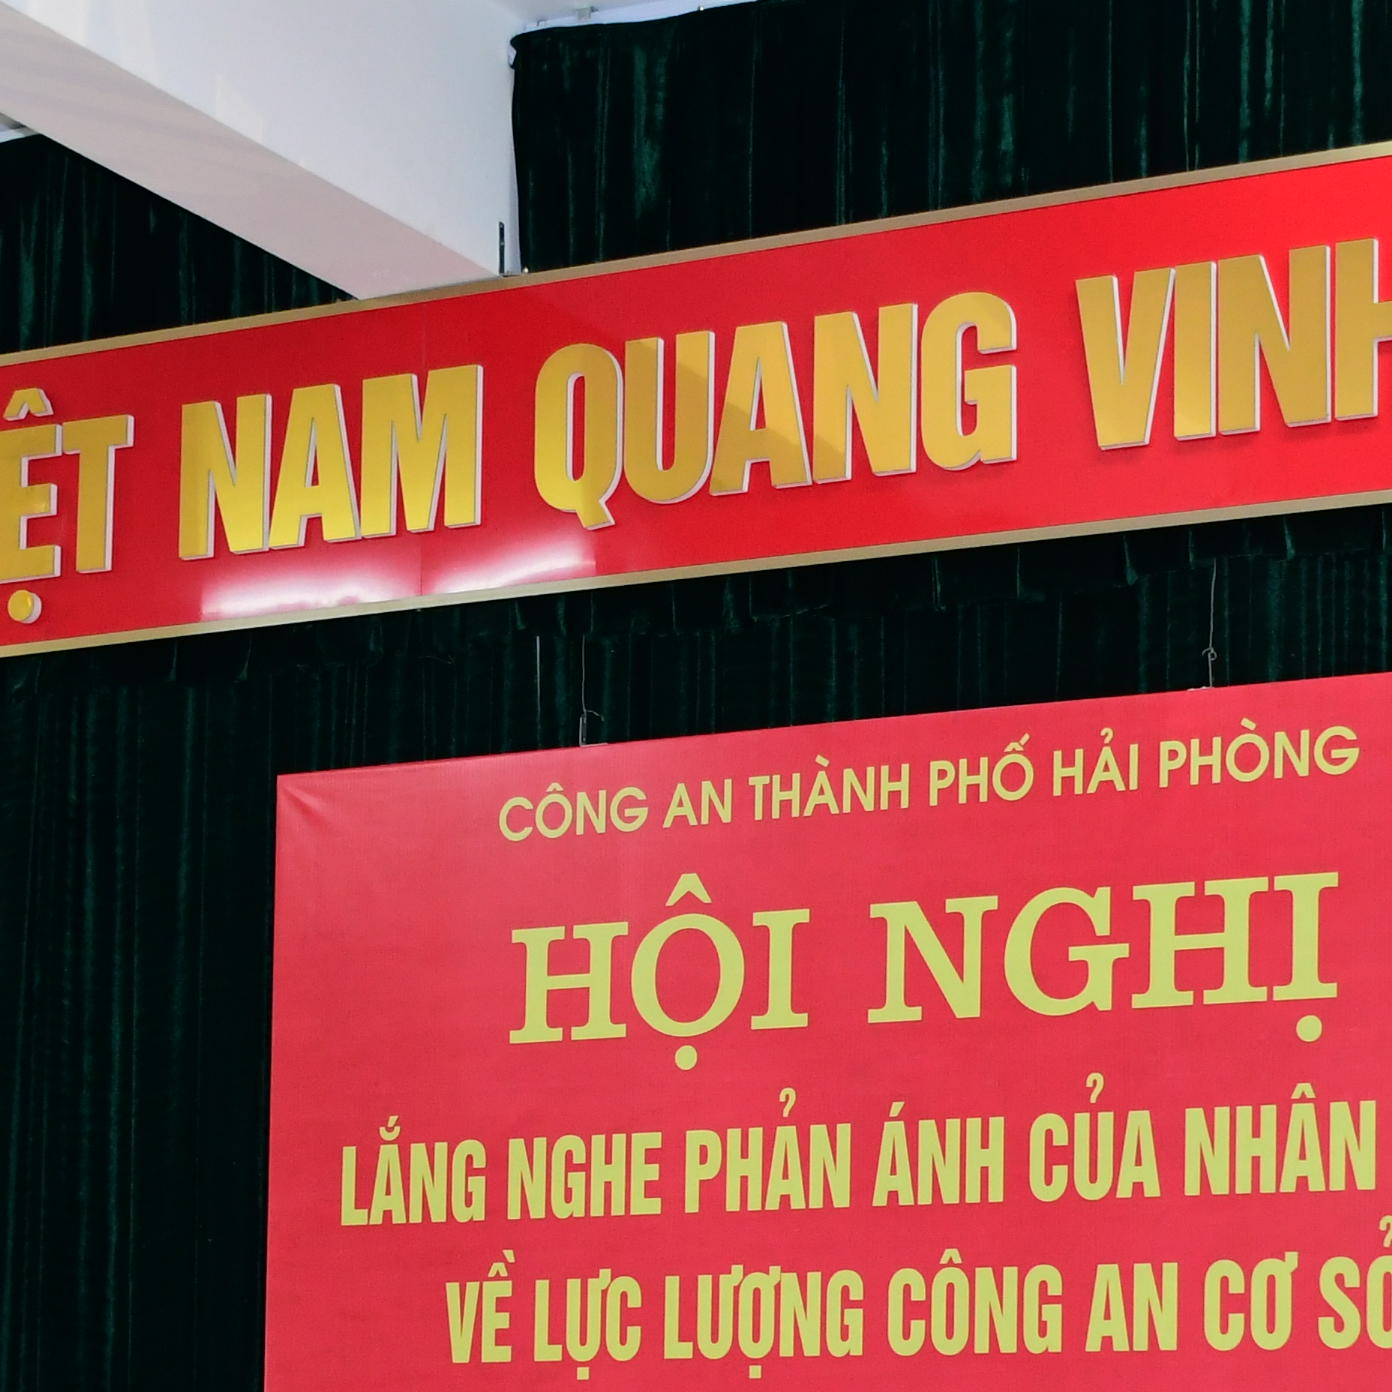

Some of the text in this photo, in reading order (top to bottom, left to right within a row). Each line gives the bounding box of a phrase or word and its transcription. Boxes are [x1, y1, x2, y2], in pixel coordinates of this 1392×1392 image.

[177, 362, 488, 562] NAM
[532, 288, 1021, 533] QUANG
[497, 716, 1362, 844] CÔNG AN THÀNH PHỐ HẢI PHÒNG
[507, 870, 1342, 1073] HỘI NGHỊ
[339, 1113, 488, 1228] LẮNG
[505, 1128, 665, 1222] NGHE
[683, 1086, 853, 1215] PHẢN
[870, 1099, 1007, 1208] ÁNH
[1027, 1070, 1163, 1204] CỦA
[1182, 1080, 1378, 1198] NHÂN
[444, 1246, 519, 1365] VỀ
[532, 1262, 644, 1382] LỰC
[662, 1257, 866, 1381] LƯỢNG
[885, 1246, 1065, 1359] CÔNG
[1083, 1262, 1180, 1354] AN
[1202, 1251, 1300, 1353] CƠ
